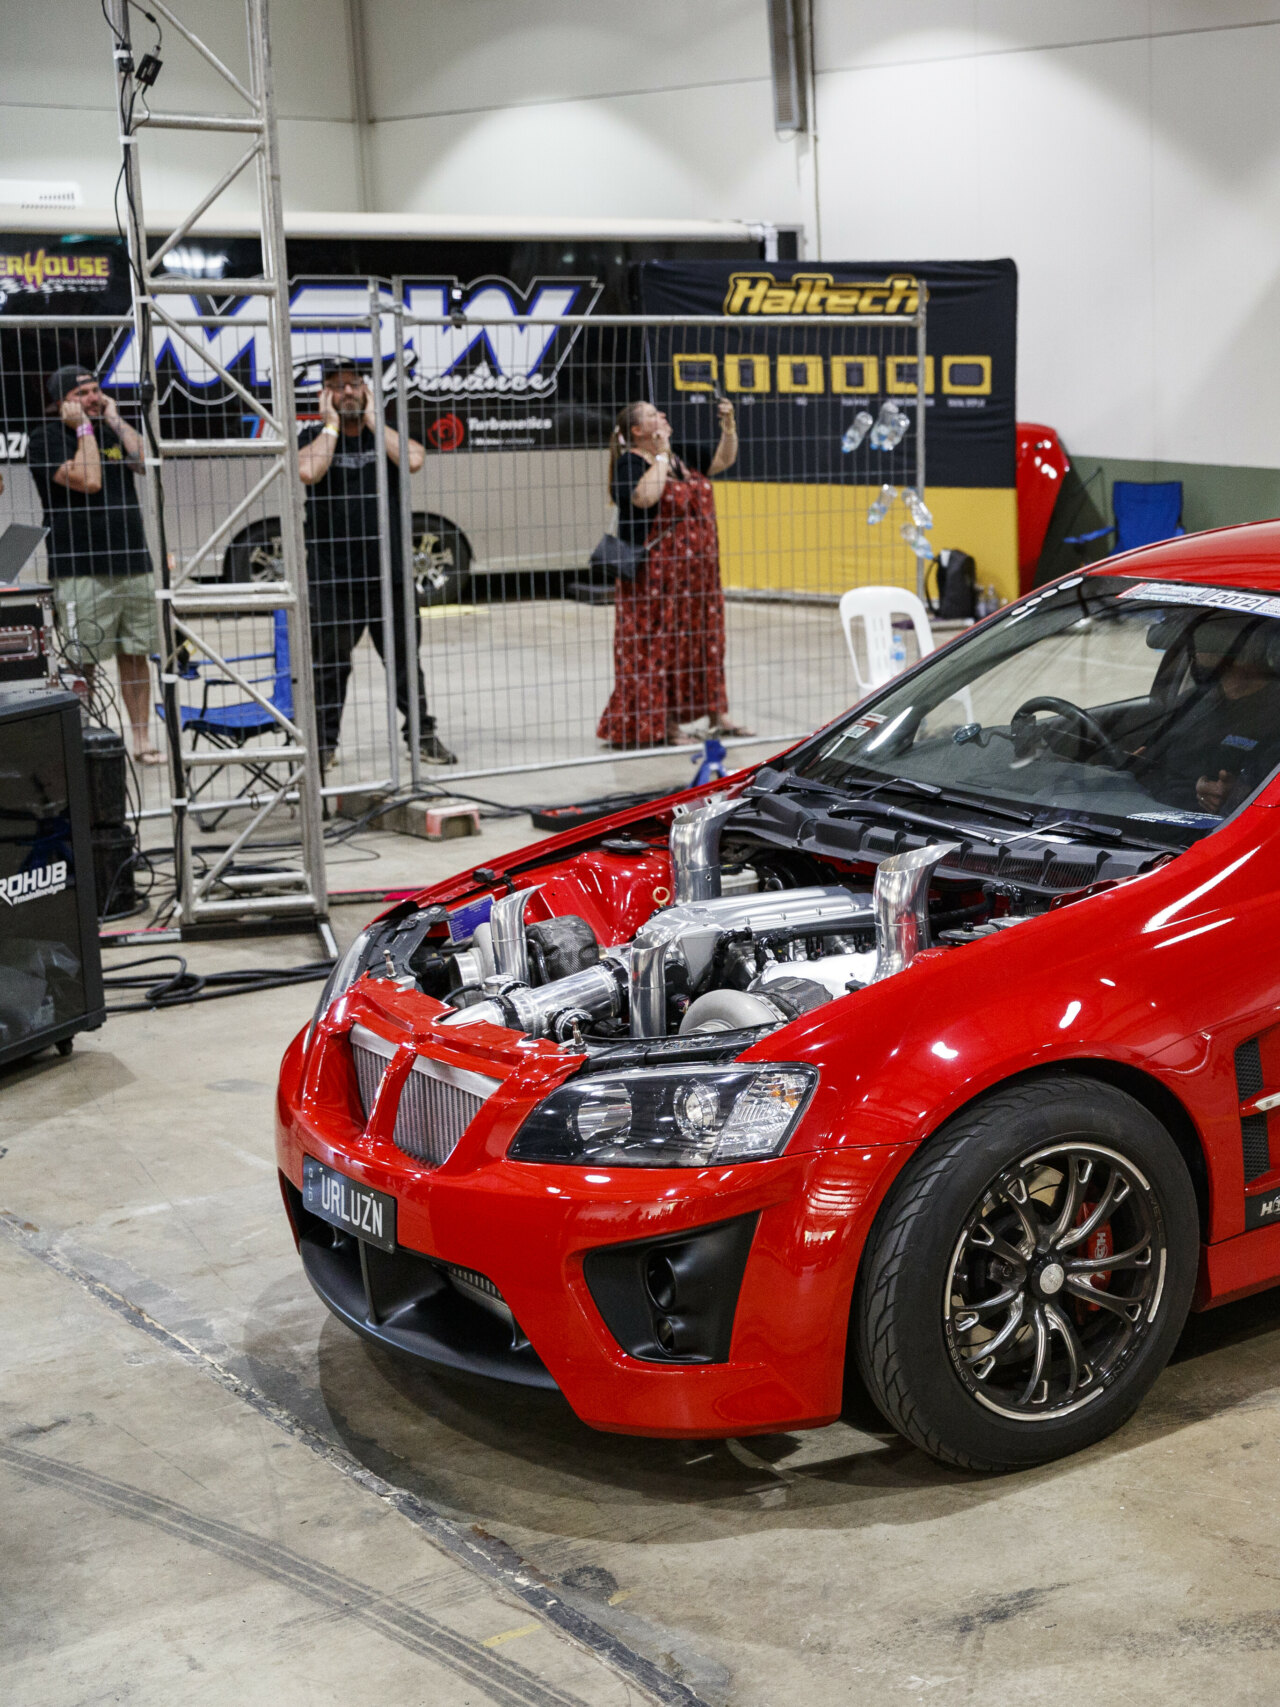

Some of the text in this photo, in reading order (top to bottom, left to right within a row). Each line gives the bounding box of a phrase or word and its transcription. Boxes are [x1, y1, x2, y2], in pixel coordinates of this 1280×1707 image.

[728, 278, 920, 315] Haltech
[467, 416, 552, 431] Turbonetics
[1208, 594, 1262, 608] 2072
[321, 1174, 383, 1238] URLUZN
